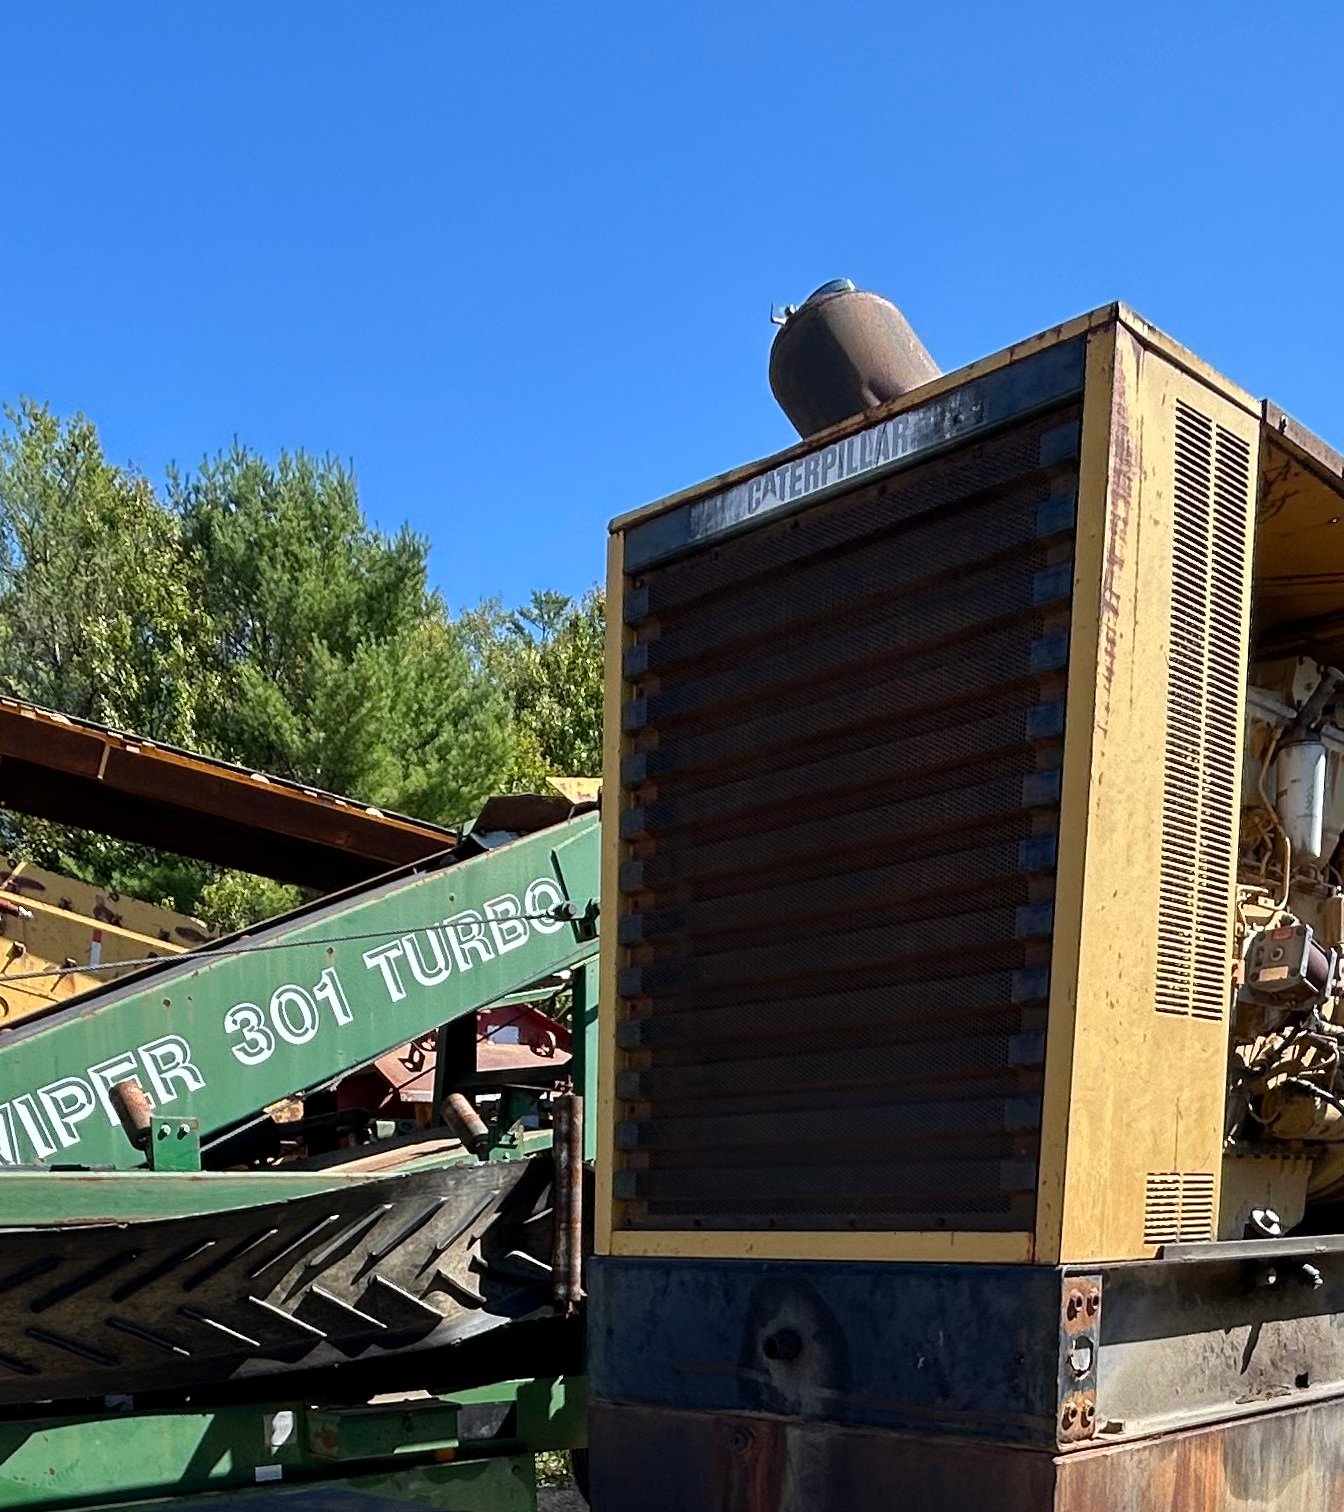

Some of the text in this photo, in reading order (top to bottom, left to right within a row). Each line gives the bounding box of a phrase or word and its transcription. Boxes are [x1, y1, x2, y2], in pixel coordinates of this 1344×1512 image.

[747, 418, 913, 515] CATERPILLAR
[223, 966, 354, 1066] 301
[361, 876, 567, 1003] TURBO
